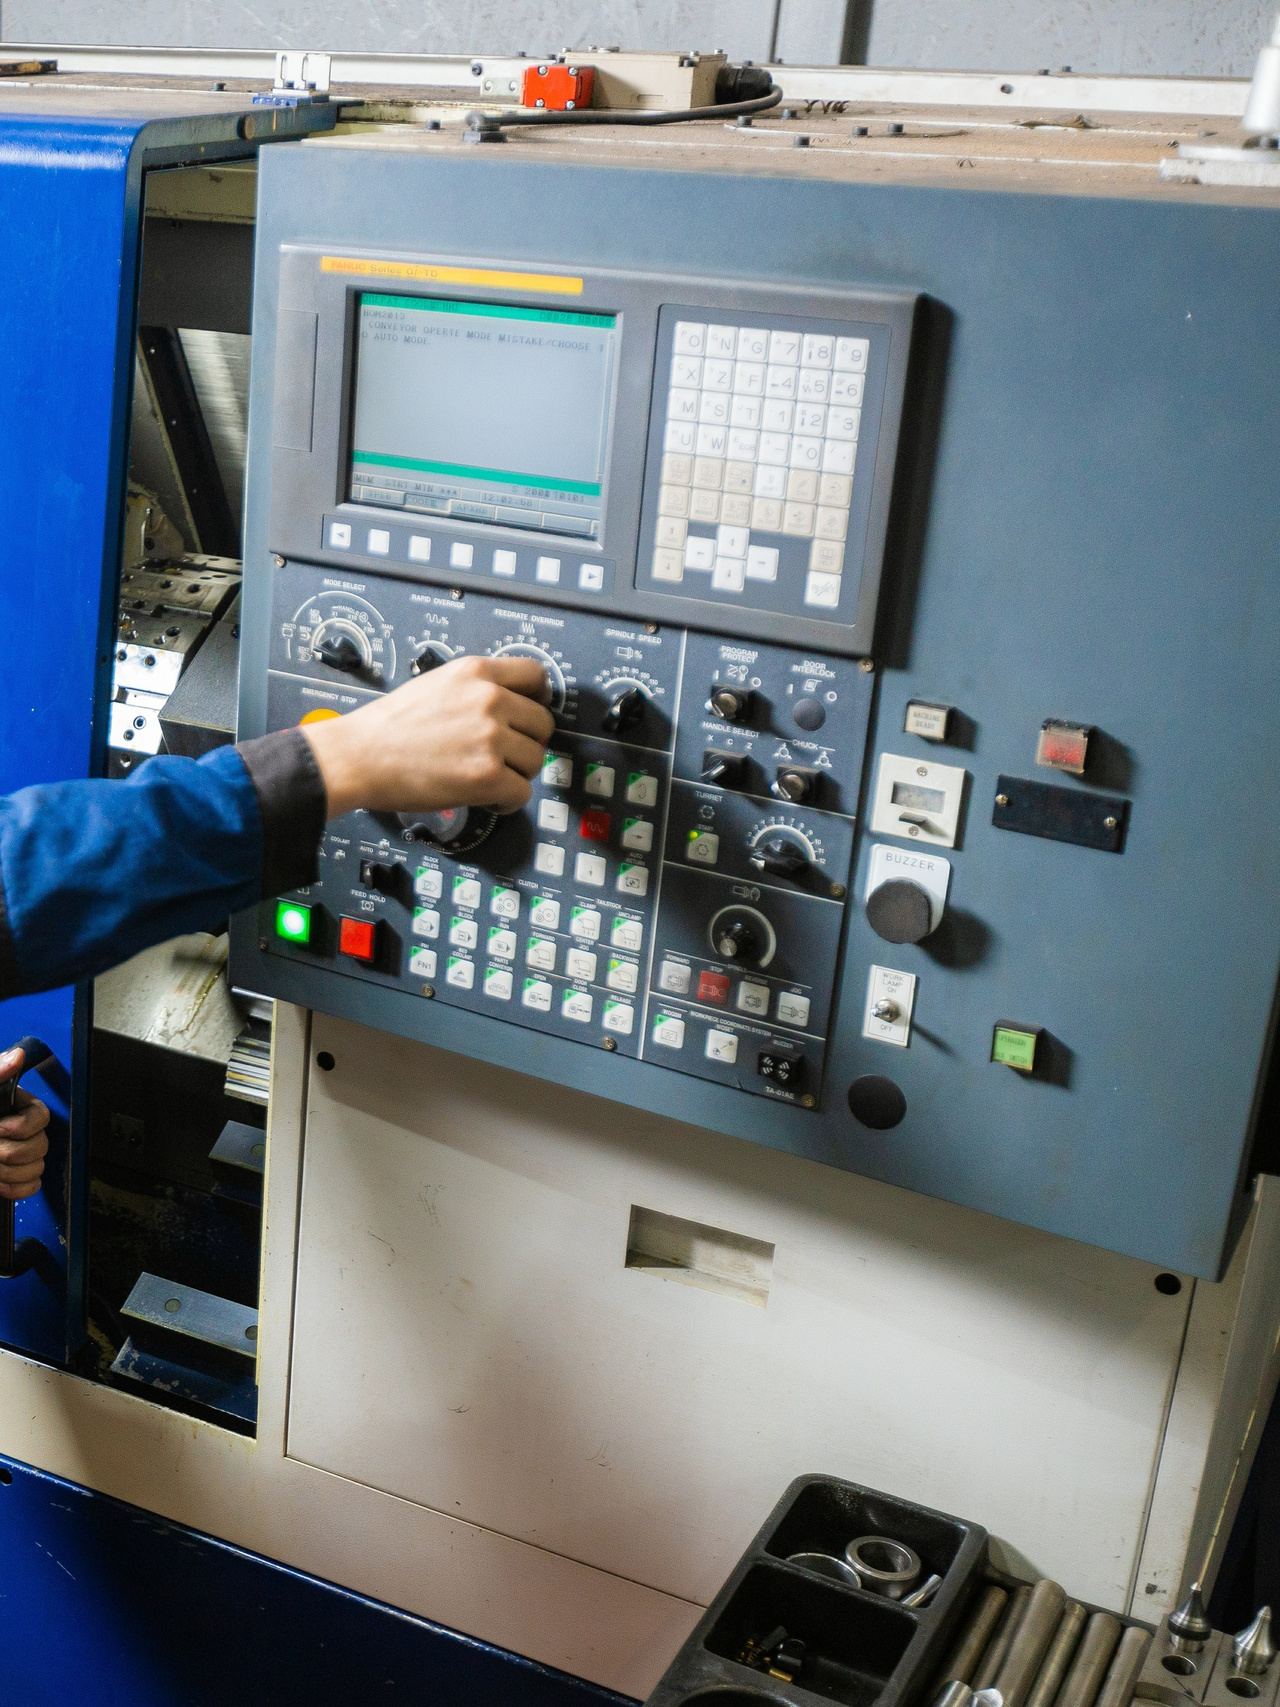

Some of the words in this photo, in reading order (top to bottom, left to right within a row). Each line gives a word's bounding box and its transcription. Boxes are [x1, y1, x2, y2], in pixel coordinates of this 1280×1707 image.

[331, 260, 367, 272] FANUC
[370, 264, 402, 276] Series
[368, 320, 418, 334] CONVEYOR
[423, 325, 461, 338] OPERTE
[466, 330, 493, 341] MODE
[374, 332, 399, 343] AUTO
[721, 339, 731, 351] N
[751, 341, 763, 354] G
[785, 342, 796, 355] 7
[818, 346, 829, 359] 8
[851, 349, 862, 362] 9
[686, 368, 696, 381] X
[717, 371, 728, 383] Z
[749, 374, 759, 386] F
[782, 377, 793, 389] 4
[814, 379, 825, 392] 5
[847, 383, 858, 397] 6
[682, 401, 694, 413] M
[714, 404, 725, 417] S
[746, 408, 757, 420] T
[778, 410, 786, 422] 1
[810, 413, 822, 426] 2
[843, 417, 854, 430] 3
[681, 433, 692, 446] U
[711, 437, 724, 449] W
[324, 577, 341, 589] MODE
[343, 580, 366, 591] SELECT
[411, 593, 432, 604] RAPID
[433, 597, 466, 609] OVERRIDE
[495, 608, 529, 621] FEEDRATE
[531, 615, 565, 627] OVERRIDE
[283, 622, 297, 630] AUTO
[381, 623, 394, 631] MAN
[606, 628, 635, 640] SPINDLE
[639, 634, 662, 645] SPEED
[721, 646, 759, 659] PROGRAM
[722, 652, 757, 664] PROTECT
[803, 660, 827, 670] DOOR
[792, 664, 837, 679] INTERLOCK
[302, 687, 340, 700] EMERGENCY
[341, 695, 358, 704] STOP
[702, 721, 732, 733] HANDLE
[733, 727, 761, 739] SELECT
[708, 734, 714, 742] X
[727, 738, 734, 746] C
[792, 738, 820, 751] CHUCK
[695, 790, 724, 802] TURRET
[359, 845, 374, 854] AUTO
[423, 855, 439, 863] BLOCK
[629, 852, 644, 860] AUTO
[885, 851, 936, 873] BUZZER
[422, 862, 440, 870] DELETE
[462, 871, 476, 879] LOCK
[518, 879, 539, 889] CLUTCH
[351, 889, 367, 898] FEED
[369, 893, 387, 903] HOLD
[422, 902, 435, 910] STOP
[579, 901, 597, 910] CLAMP
[595, 898, 623, 910] TAILSTOCK
[417, 961, 432, 970] FN1
[882, 971, 906, 983] WORK
[882, 978, 904, 989] LAMP
[790, 986, 803, 994] JOG
[886, 986, 898, 995] ON
[690, 1010, 719, 1024] WORKPIECE
[718, 1017, 751, 1032] COORDINATE
[749, 1026, 772, 1037] SYSTEM
[880, 1023, 894, 1033] OFF
[772, 1038, 794, 1049] BUZZER
[765, 1086, 796, 1100] TA-01AE
